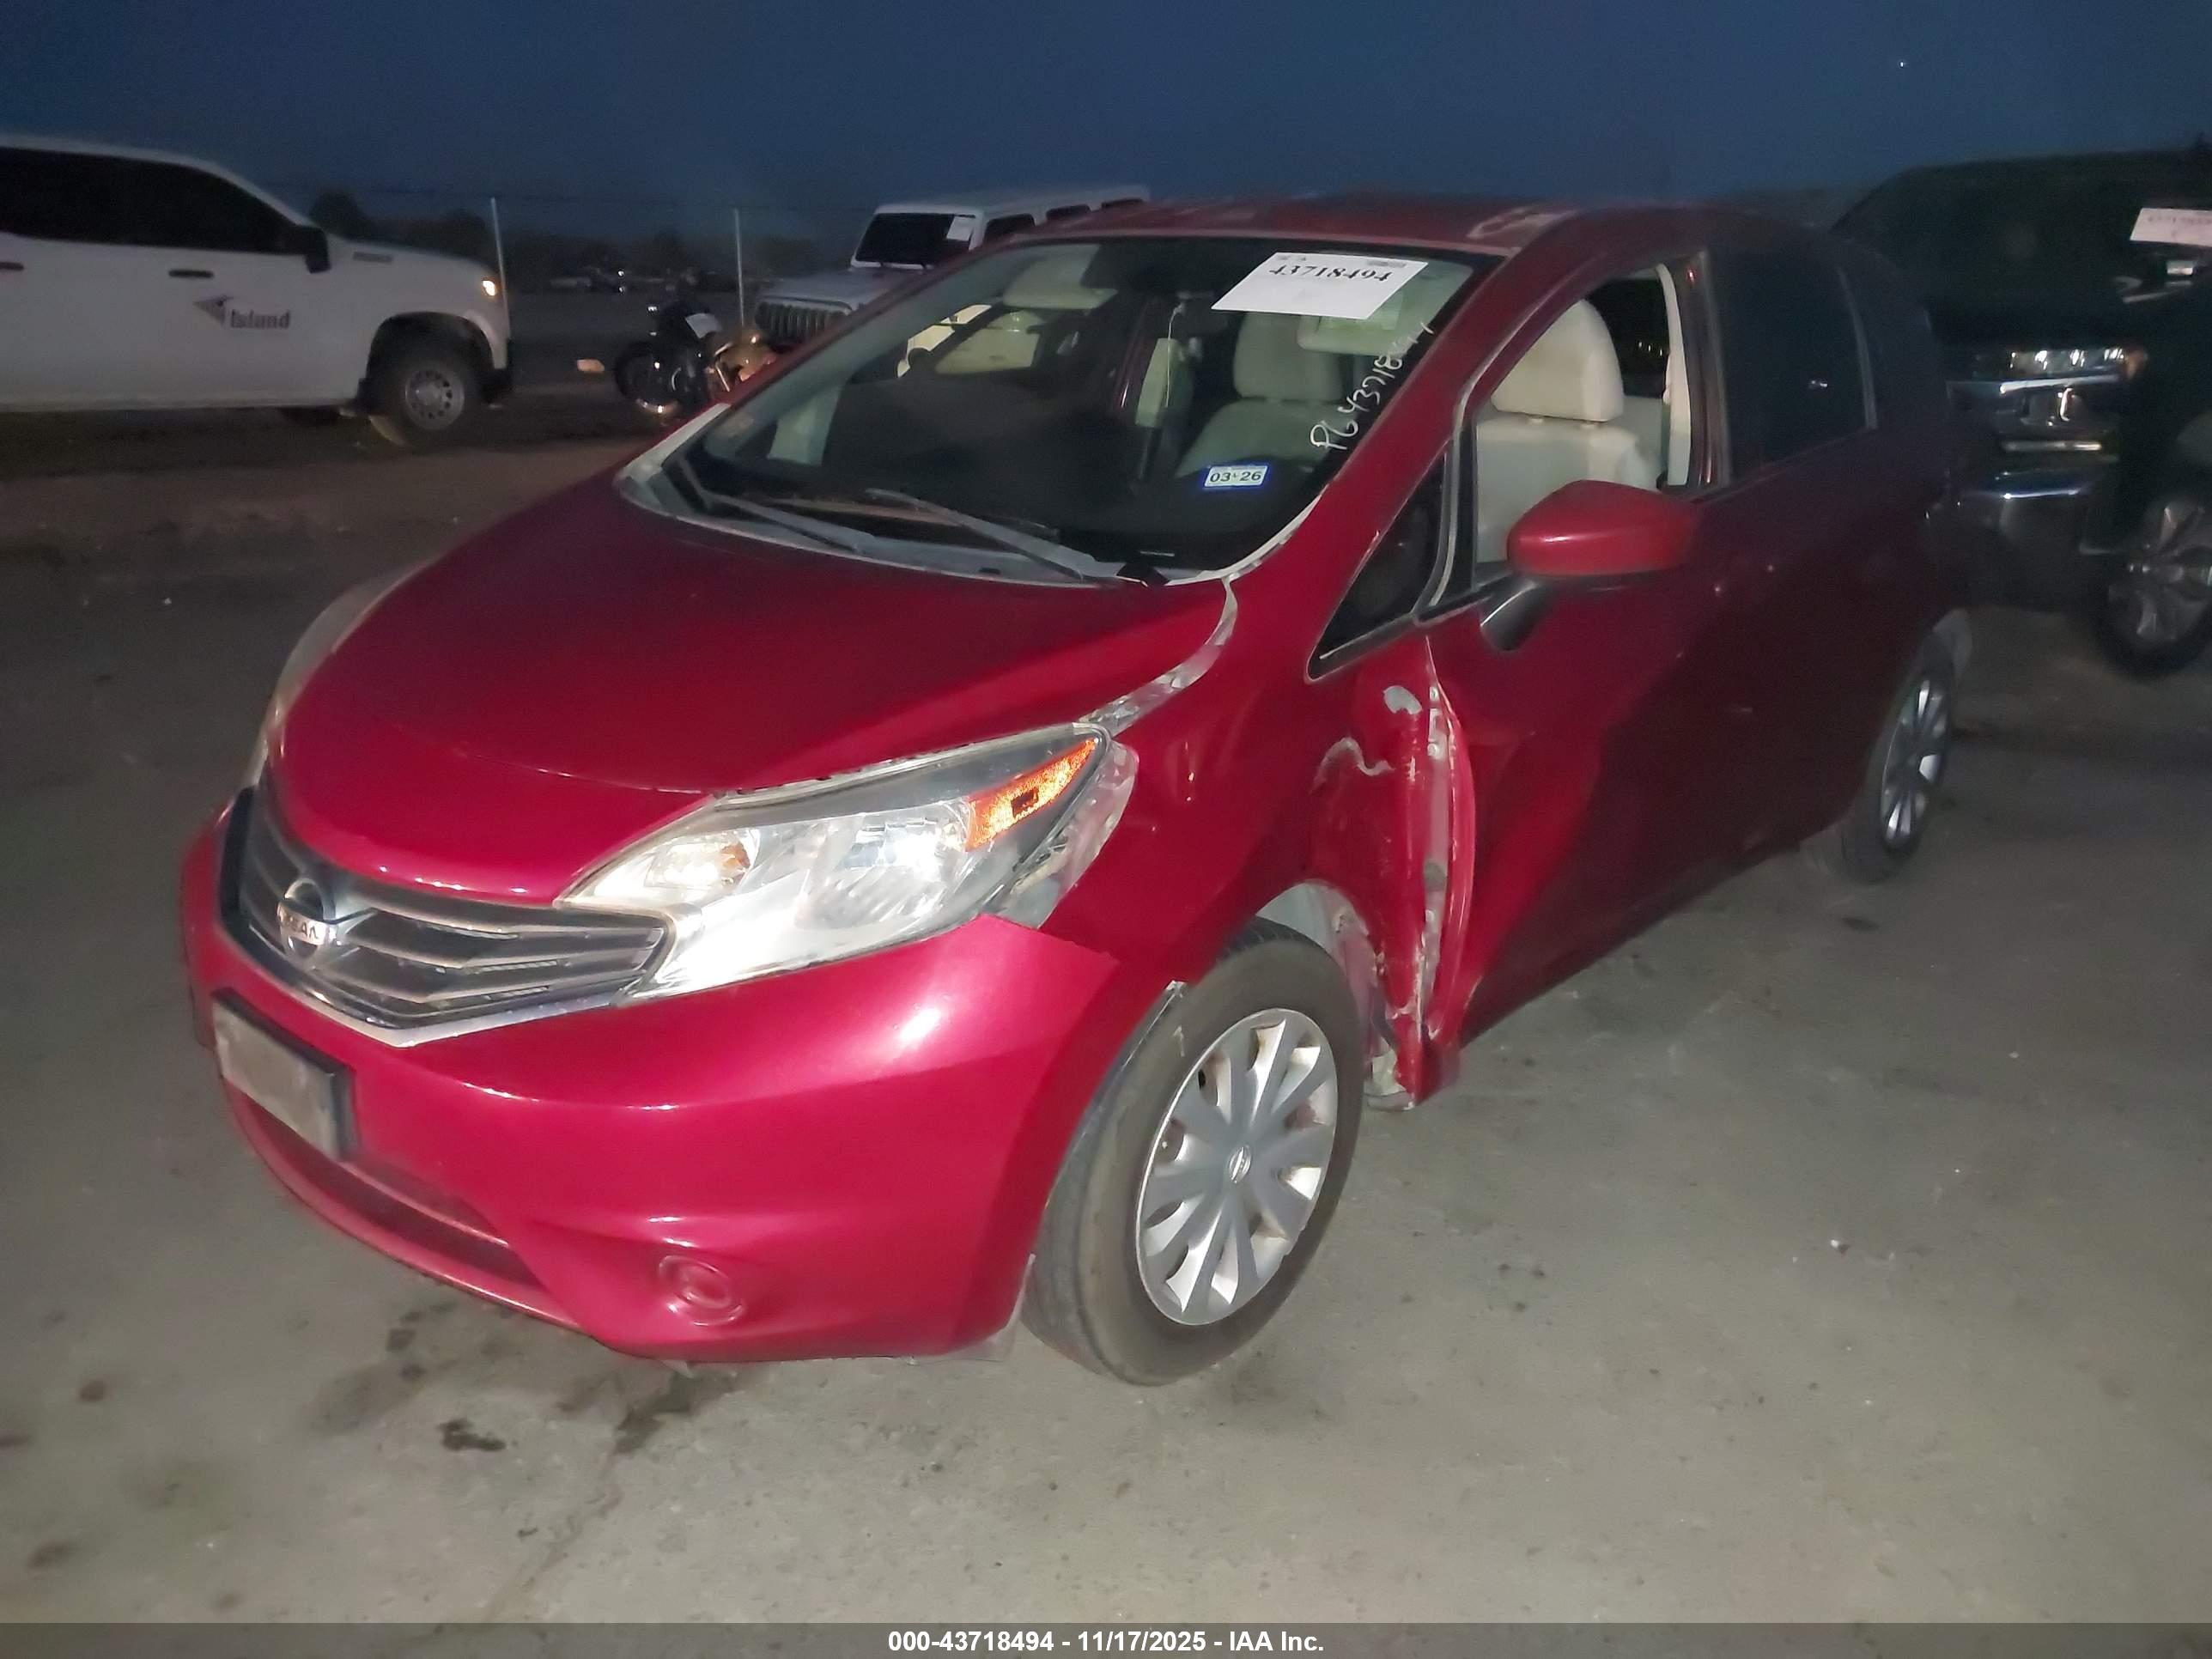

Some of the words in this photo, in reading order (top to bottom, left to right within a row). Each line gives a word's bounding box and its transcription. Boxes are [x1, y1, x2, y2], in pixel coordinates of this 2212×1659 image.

[1269, 264, 1393, 282] 43718494
[1210, 472, 1231, 482] 03
[1239, 471, 1261, 481] 26
